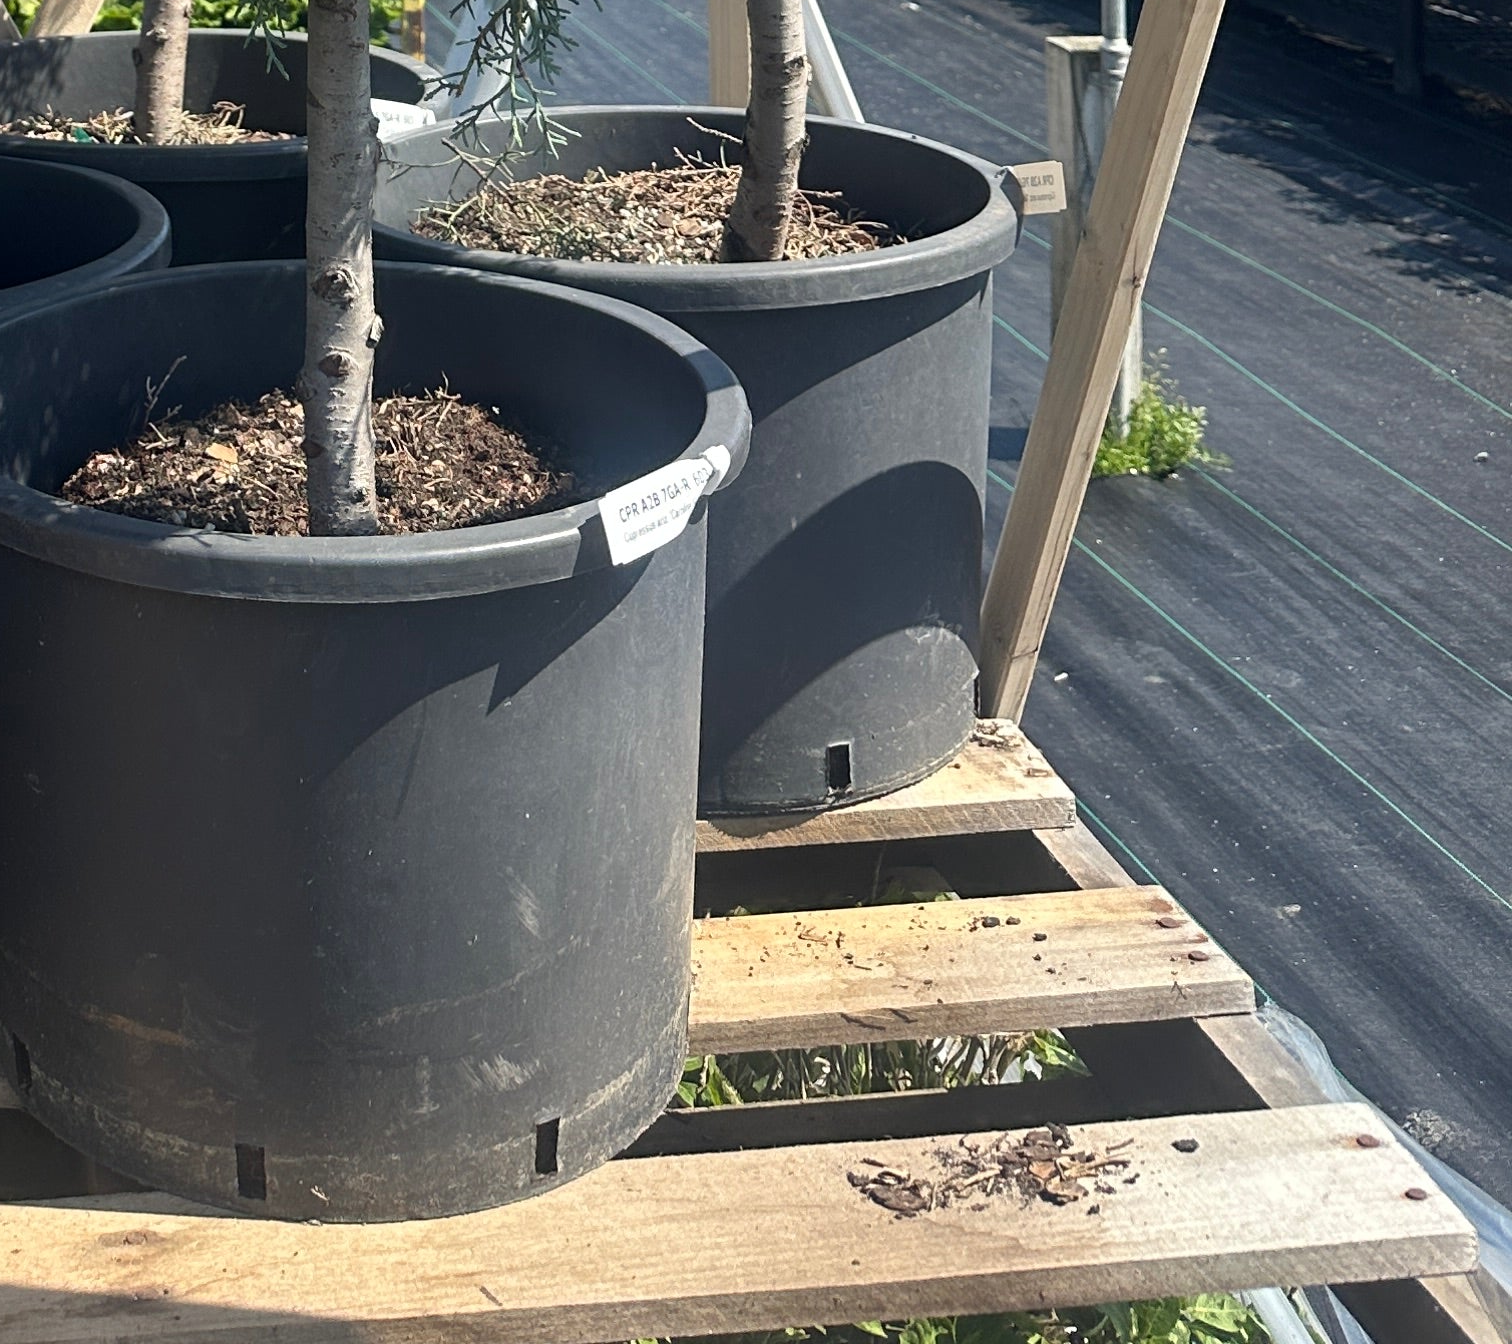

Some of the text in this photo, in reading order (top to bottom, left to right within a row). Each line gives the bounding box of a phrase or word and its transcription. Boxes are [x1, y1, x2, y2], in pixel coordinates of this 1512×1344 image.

[619, 502, 640, 523] CPR
[641, 492, 661, 513] A2B
[660, 477, 692, 503] 7GA-R
